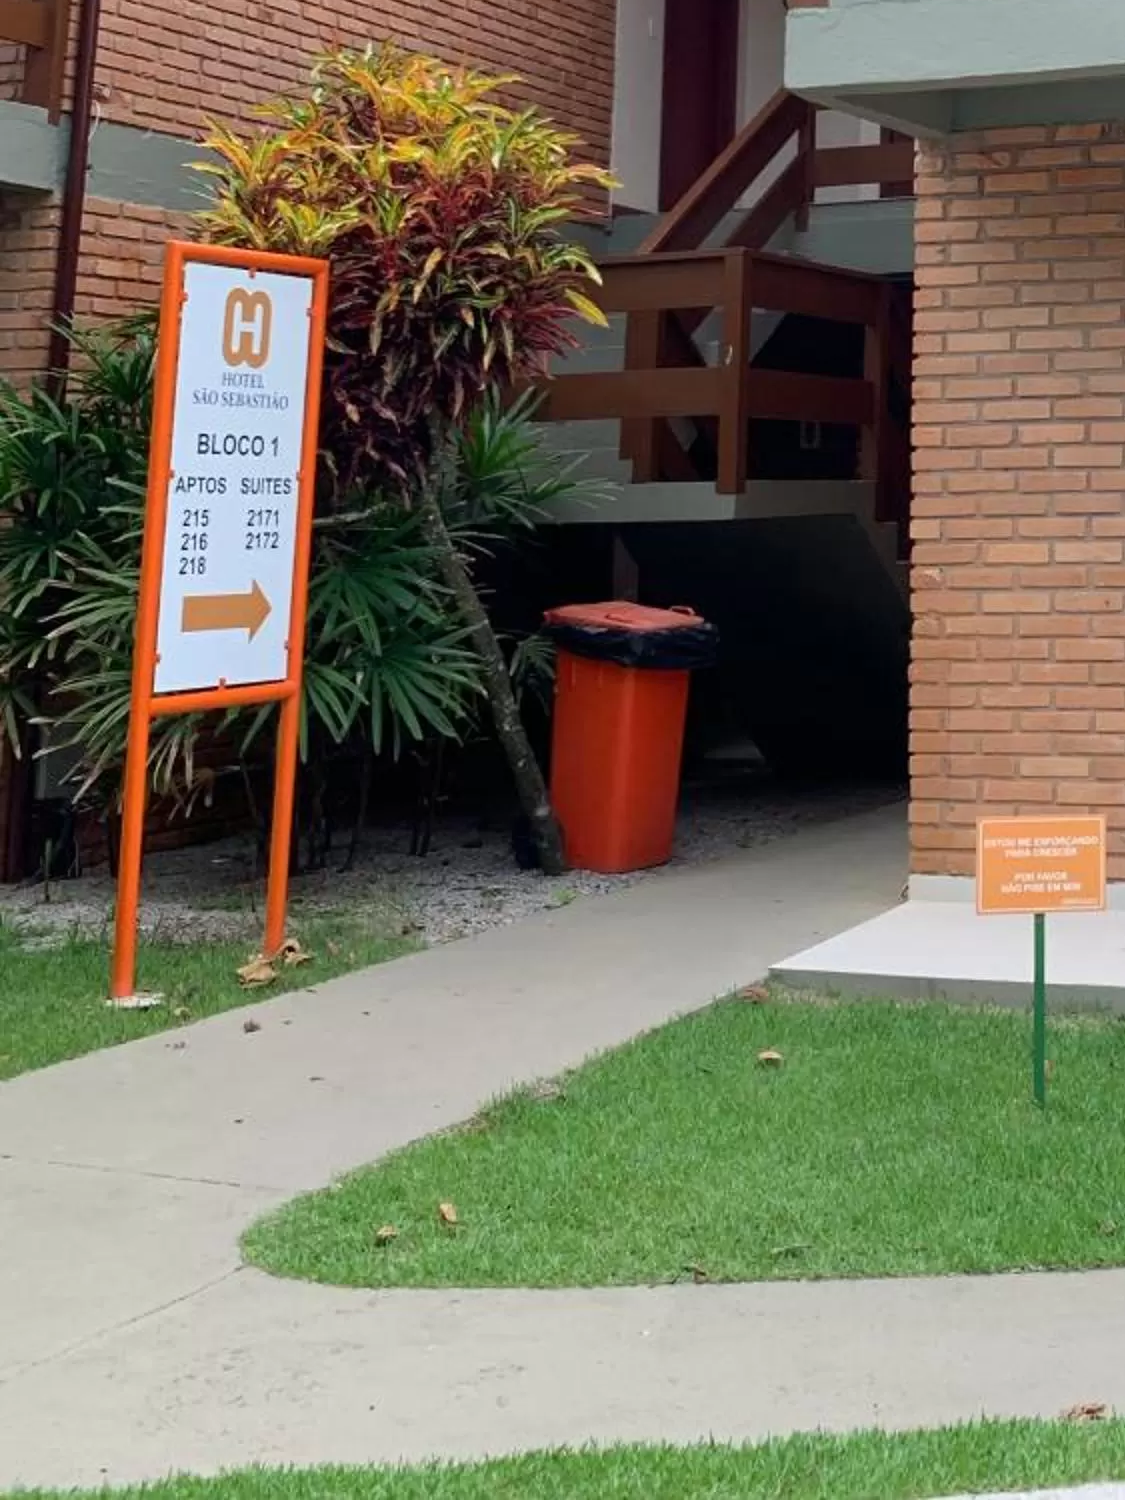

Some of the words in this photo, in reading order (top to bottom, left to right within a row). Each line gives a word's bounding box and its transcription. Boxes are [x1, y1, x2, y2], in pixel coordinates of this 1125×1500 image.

[221, 372, 265, 388] HOTEL
[192, 388, 219, 405] SÃO
[221, 391, 289, 410] SEBASTIÃO
[197, 433, 265, 456] BLOCO
[271, 436, 279, 457] 1
[175, 476, 227, 494] APTOS
[241, 477, 292, 494] SUITES
[183, 509, 209, 527] 215
[247, 509, 279, 527] 2171
[181, 533, 208, 551] 216
[245, 531, 279, 549] 2172
[179, 556, 206, 575] 218
